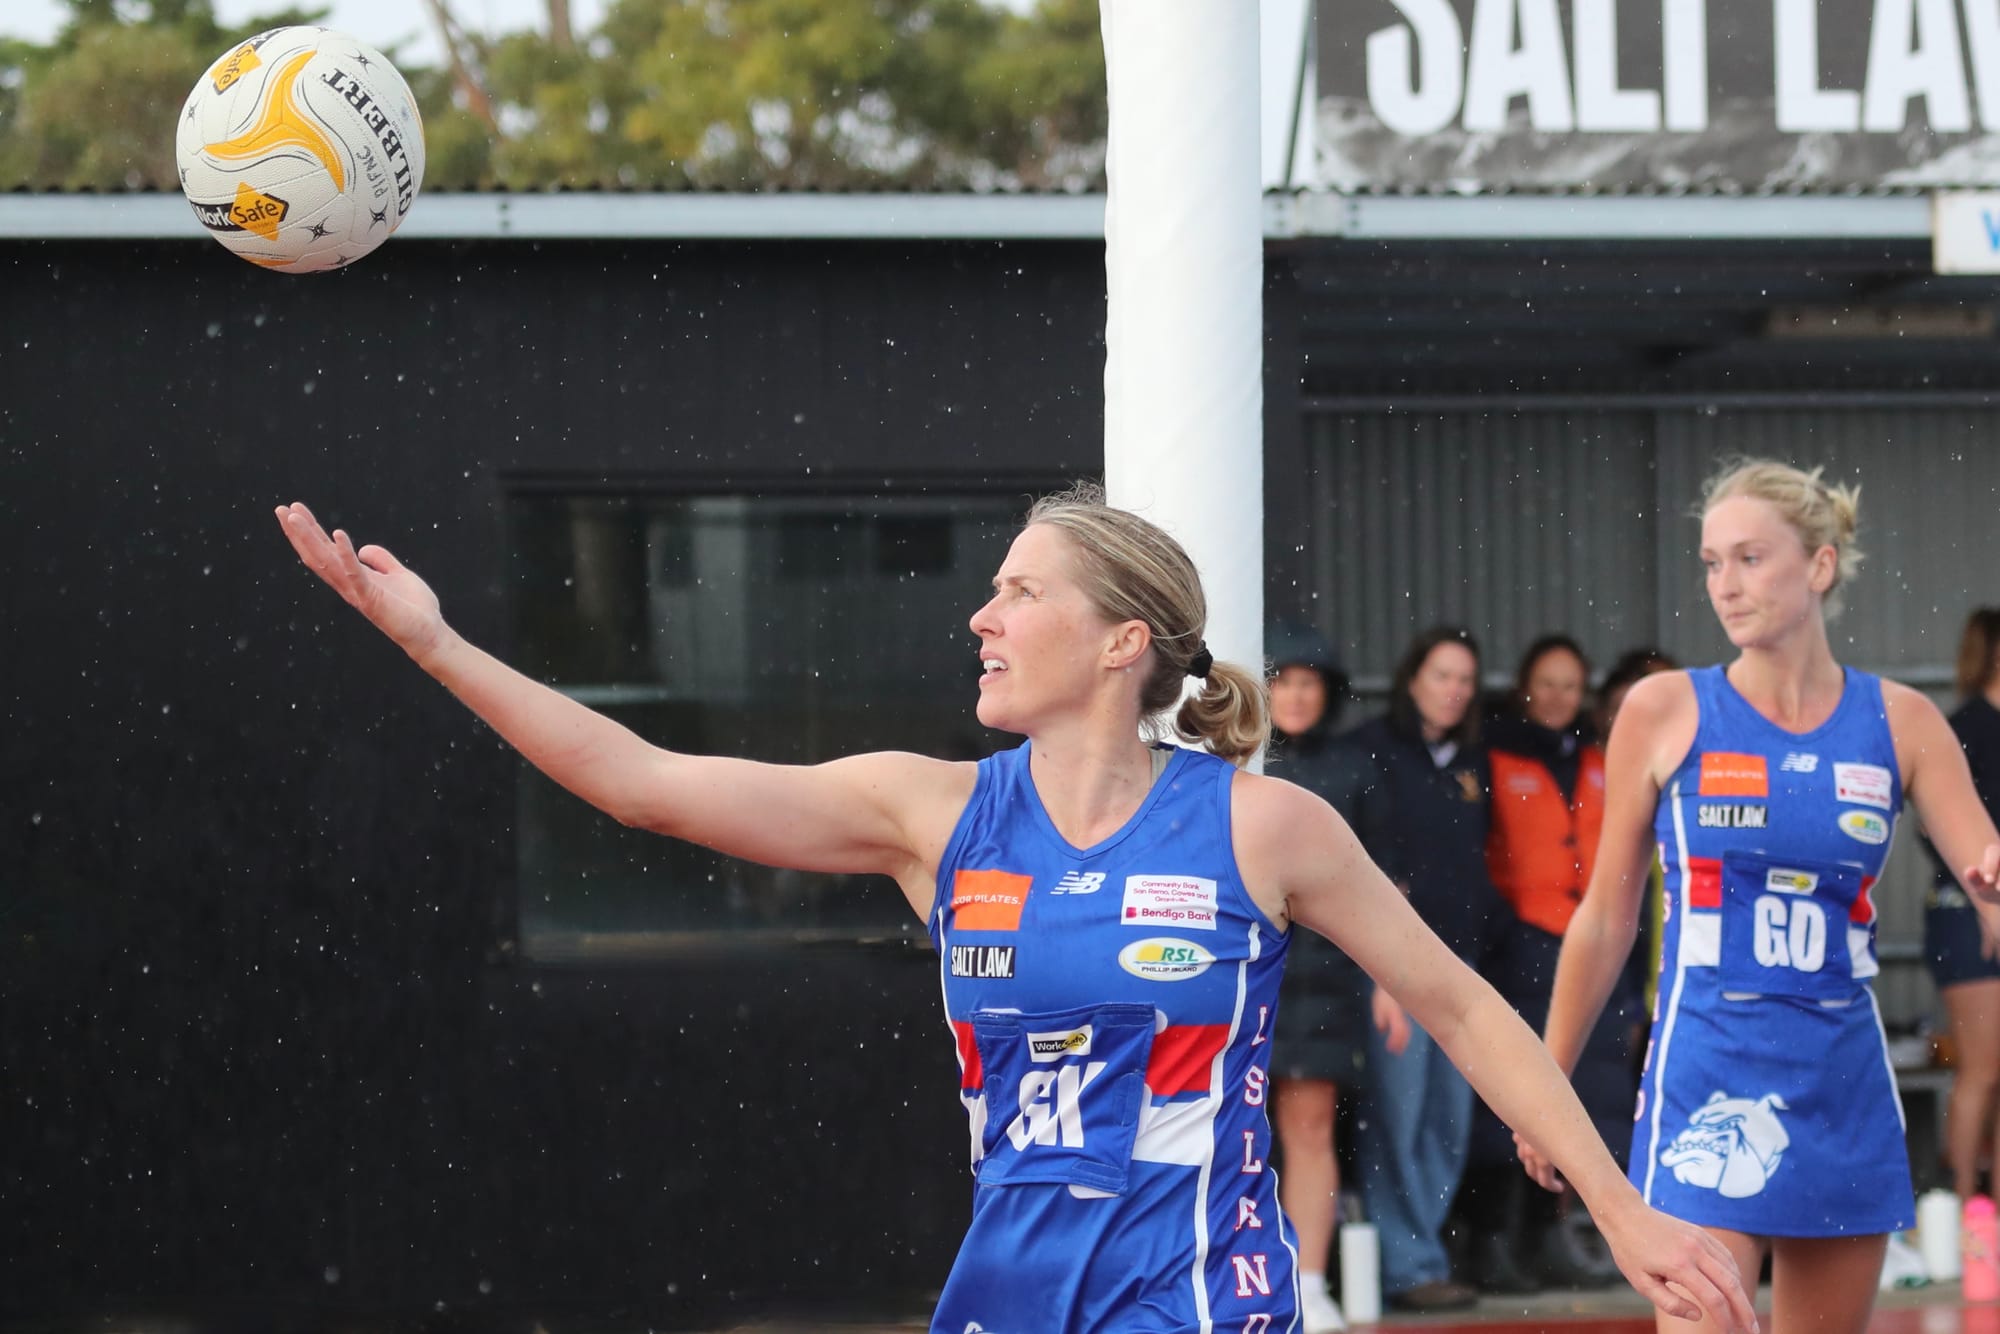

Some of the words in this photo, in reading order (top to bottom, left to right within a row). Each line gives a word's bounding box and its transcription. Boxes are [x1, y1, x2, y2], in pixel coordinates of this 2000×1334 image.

[320, 68, 414, 217] GILBERT
[1698, 804, 1733, 828] SALT
[1141, 880, 1182, 889] Community
[1182, 882, 1200, 891] Bank
[1141, 908, 1185, 920] Bendigo
[1187, 910, 1213, 921] Bank
[1754, 895, 1827, 973] GD
[951, 945, 976, 977] SALT
[976, 946, 1014, 978] LAW.
[1160, 947, 1199, 962] RSL
[1006, 1061, 1107, 1152] GK
